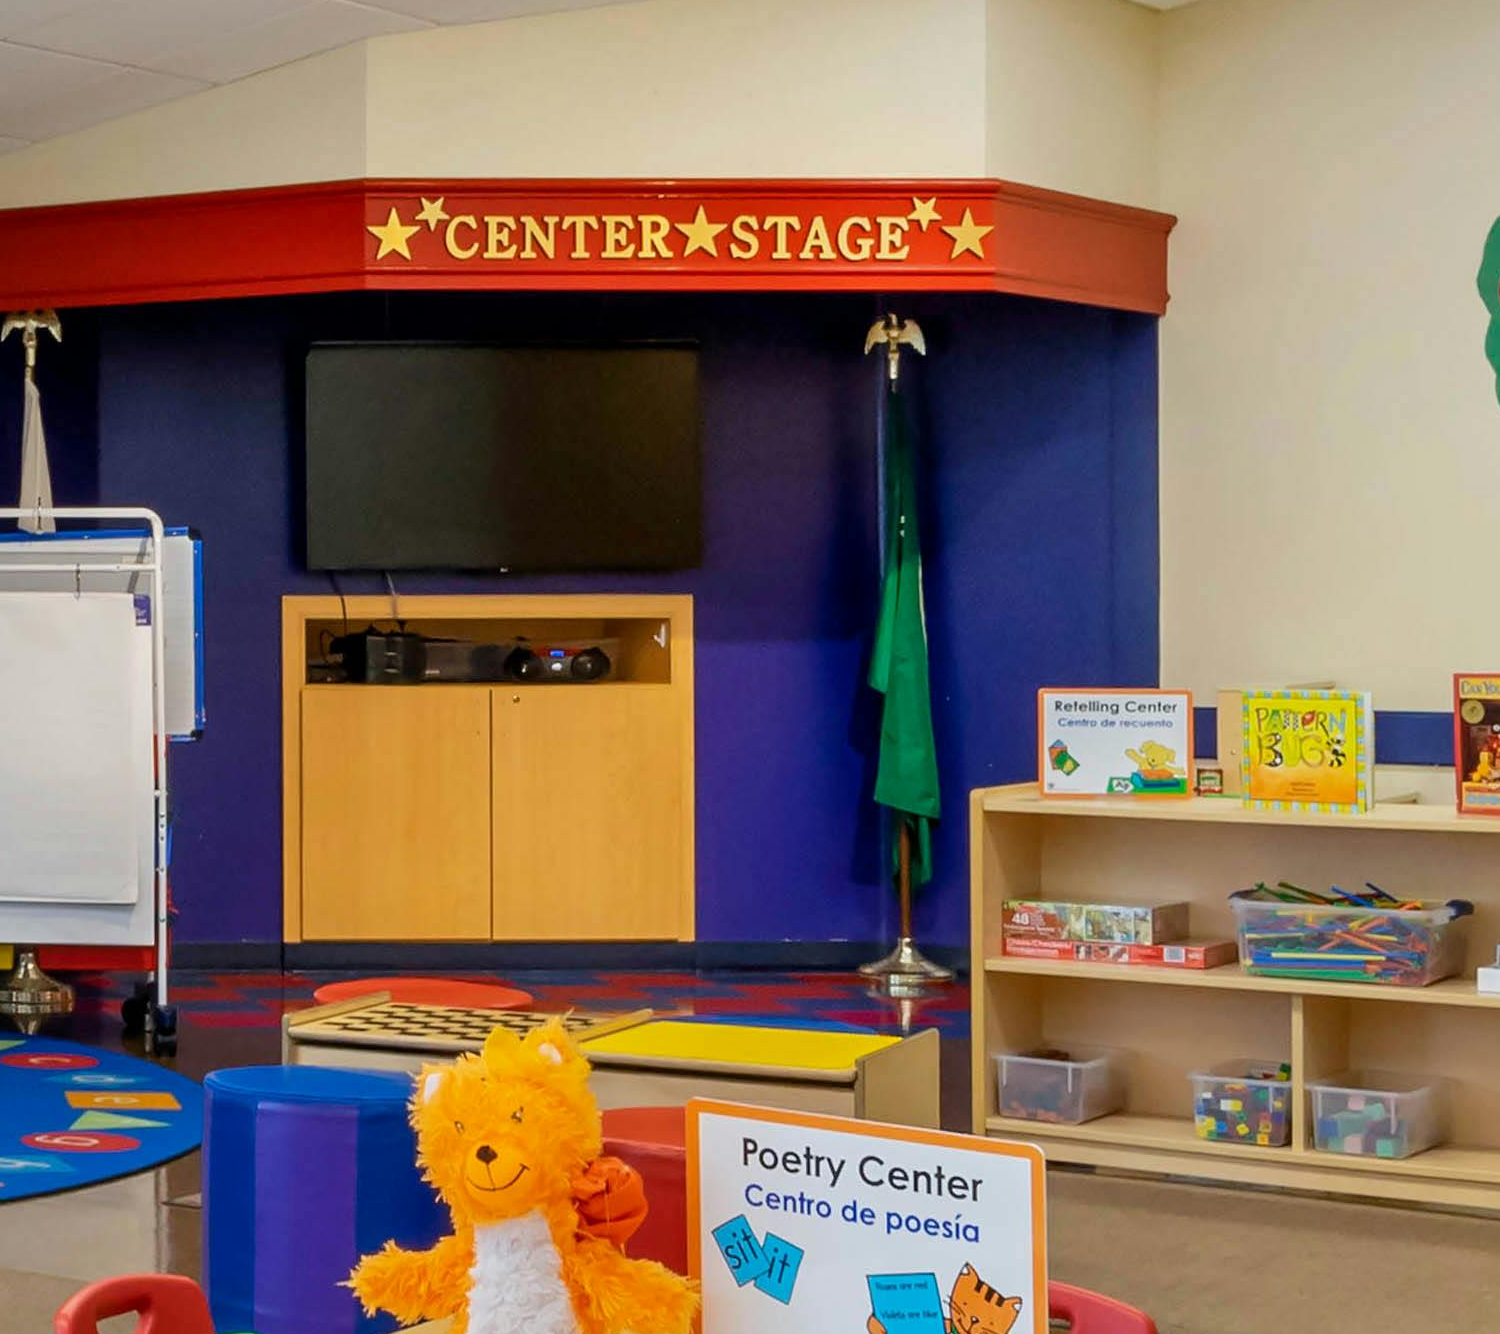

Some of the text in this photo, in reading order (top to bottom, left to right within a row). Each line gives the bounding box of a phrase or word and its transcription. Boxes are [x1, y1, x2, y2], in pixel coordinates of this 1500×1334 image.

[444, 214, 911, 261] CENTER STAGE
[1055, 700, 1177, 714] Retelling Center
[1057, 717, 1173, 728] Centro de recuento
[742, 1137, 983, 1202] Poetry Center
[744, 1183, 980, 1243] Centro de poesía
[724, 1228, 758, 1270] sit
[768, 1247, 791, 1284] it
